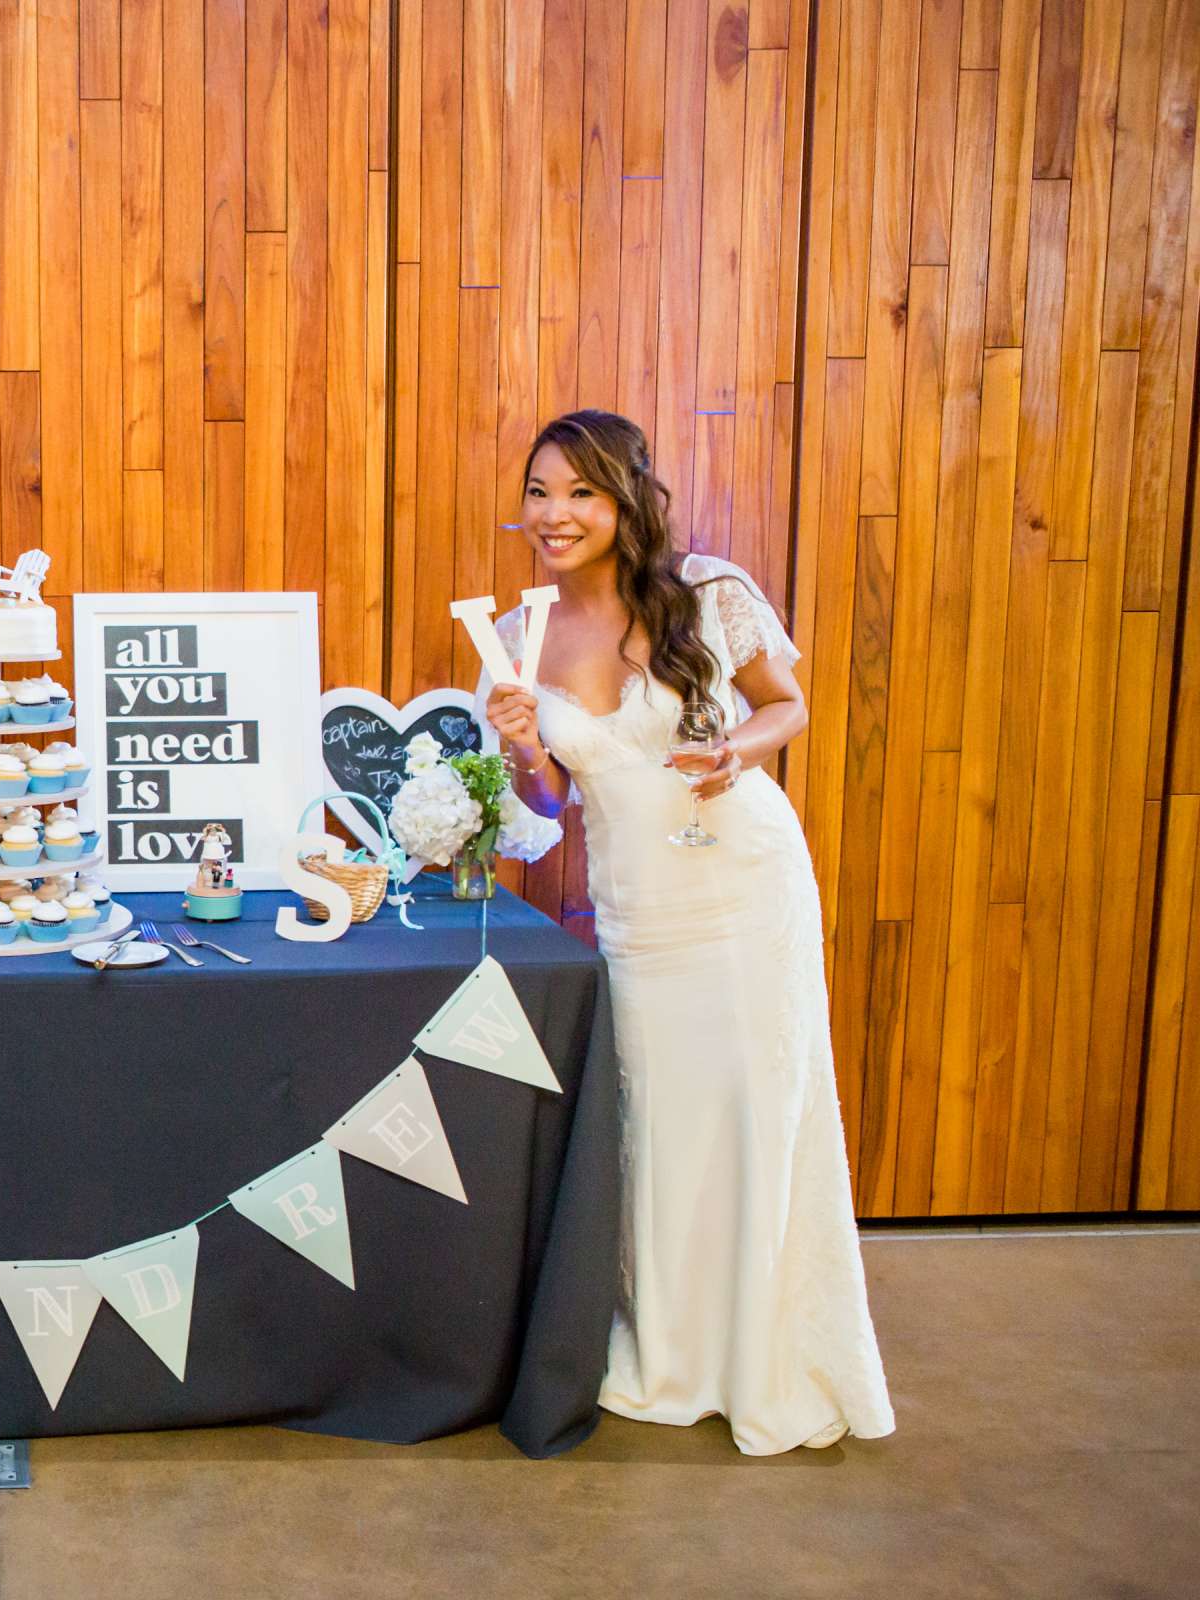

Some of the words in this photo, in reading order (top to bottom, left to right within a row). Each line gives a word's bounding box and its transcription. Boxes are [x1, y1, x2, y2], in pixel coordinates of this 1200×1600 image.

[115, 628, 183, 668] all
[449, 584, 560, 695] V
[114, 675, 217, 715] you
[115, 723, 249, 763] need
[116, 770, 160, 810] is
[275, 832, 353, 942] S
